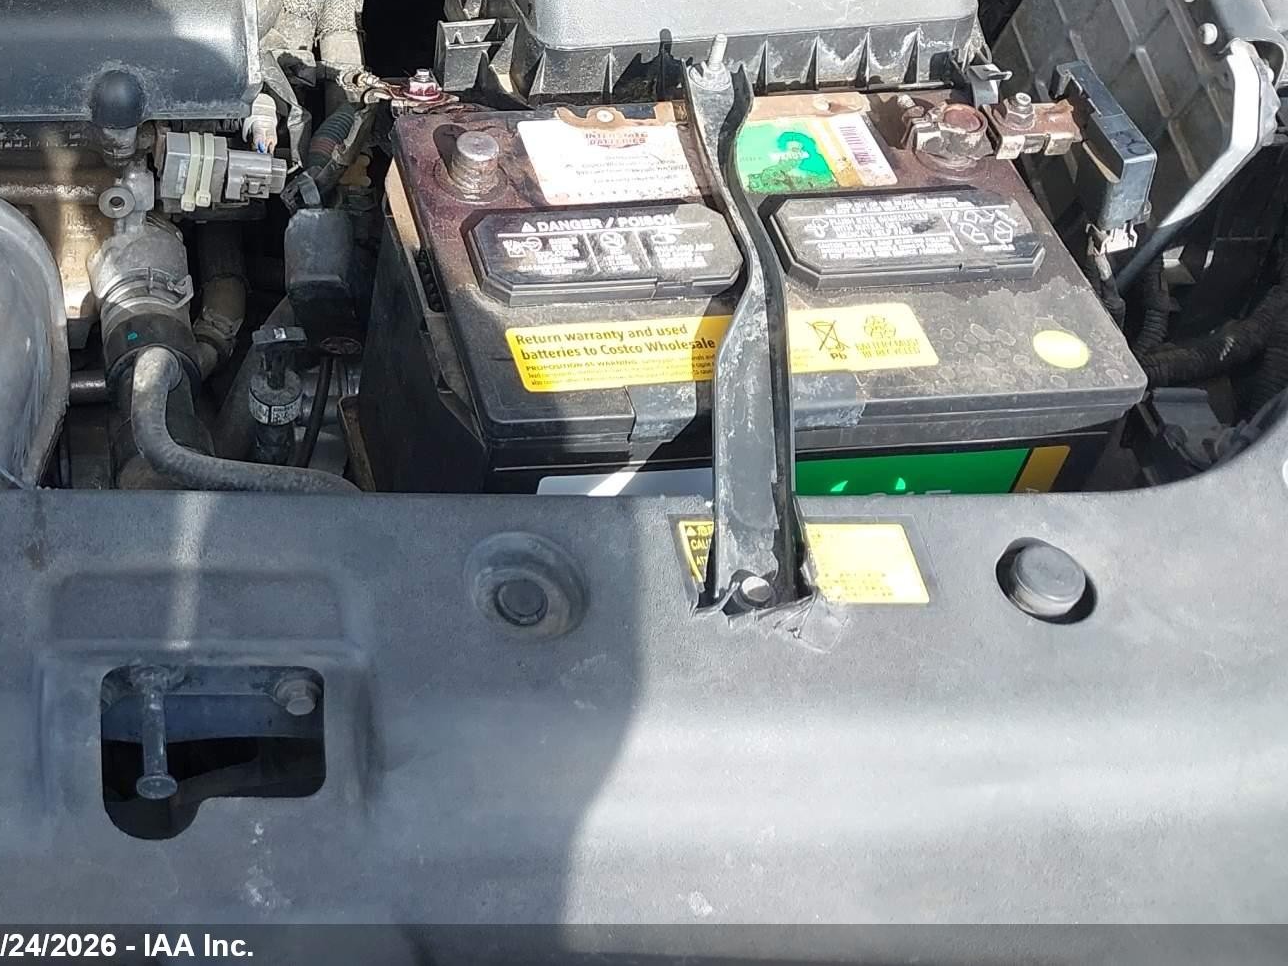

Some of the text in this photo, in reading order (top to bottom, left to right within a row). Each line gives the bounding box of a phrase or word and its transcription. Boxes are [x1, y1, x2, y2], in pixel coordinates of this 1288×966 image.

[536, 217, 603, 233] DANGER
[616, 213, 678, 228] POISON
[515, 323, 688, 346] Return warranty and used
[521, 337, 716, 360] batteries to Costco Wholesale
